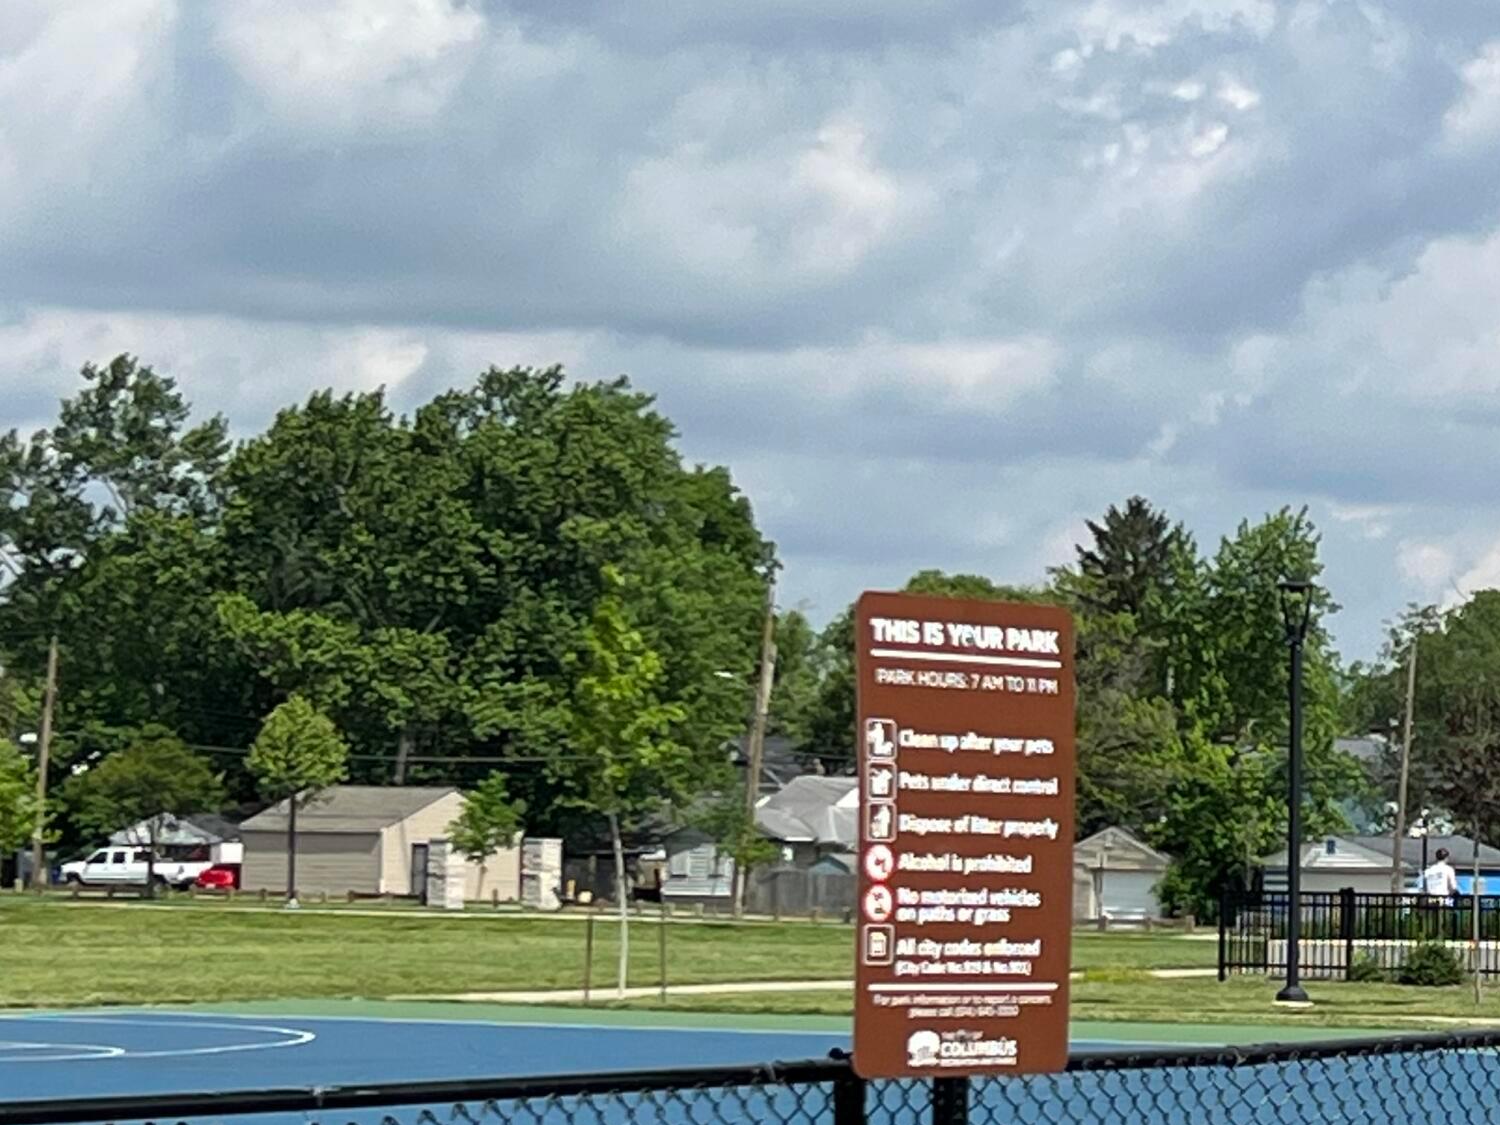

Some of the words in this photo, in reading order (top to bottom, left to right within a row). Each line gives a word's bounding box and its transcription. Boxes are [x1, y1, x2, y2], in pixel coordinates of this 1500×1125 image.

[869, 617, 920, 644] THIS
[922, 621, 945, 646] IS
[946, 622, 1004, 650] YOUR
[1006, 627, 1060, 655] PARK
[875, 668, 915, 685] PARK
[971, 673, 980, 689] 7
[982, 674, 1004, 691] AM
[1005, 675, 1024, 692] TO
[1039, 678, 1058, 694] PM
[900, 729, 938, 747] Clean
[940, 736, 959, 752] up
[960, 732, 993, 750] after
[994, 738, 1024, 755] your
[1026, 740, 1054, 755] pets
[899, 771, 929, 789] Pets
[931, 773, 971, 791] under
[1012, 778, 1058, 794] control
[899, 814, 951, 835] Dispose
[953, 815, 970, 832] of
[1003, 818, 1058, 839] properly
[898, 853, 950, 870] Alcohol
[952, 854, 963, 871] is
[963, 854, 1032, 875] prohibited
[897, 887, 919, 904] No
[921, 888, 987, 905] motorized
[989, 889, 1041, 906] vehicles
[896, 907, 916, 921] on
[918, 906, 955, 925] paths
[957, 908, 974, 921] or
[974, 909, 1010, 925] grass
[896, 938, 916, 955] All
[918, 939, 942, 959] city
[944, 939, 982, 956] codes
[984, 938, 1041, 956] enforced
[940, 1039, 1018, 1057] COLUMBUS
